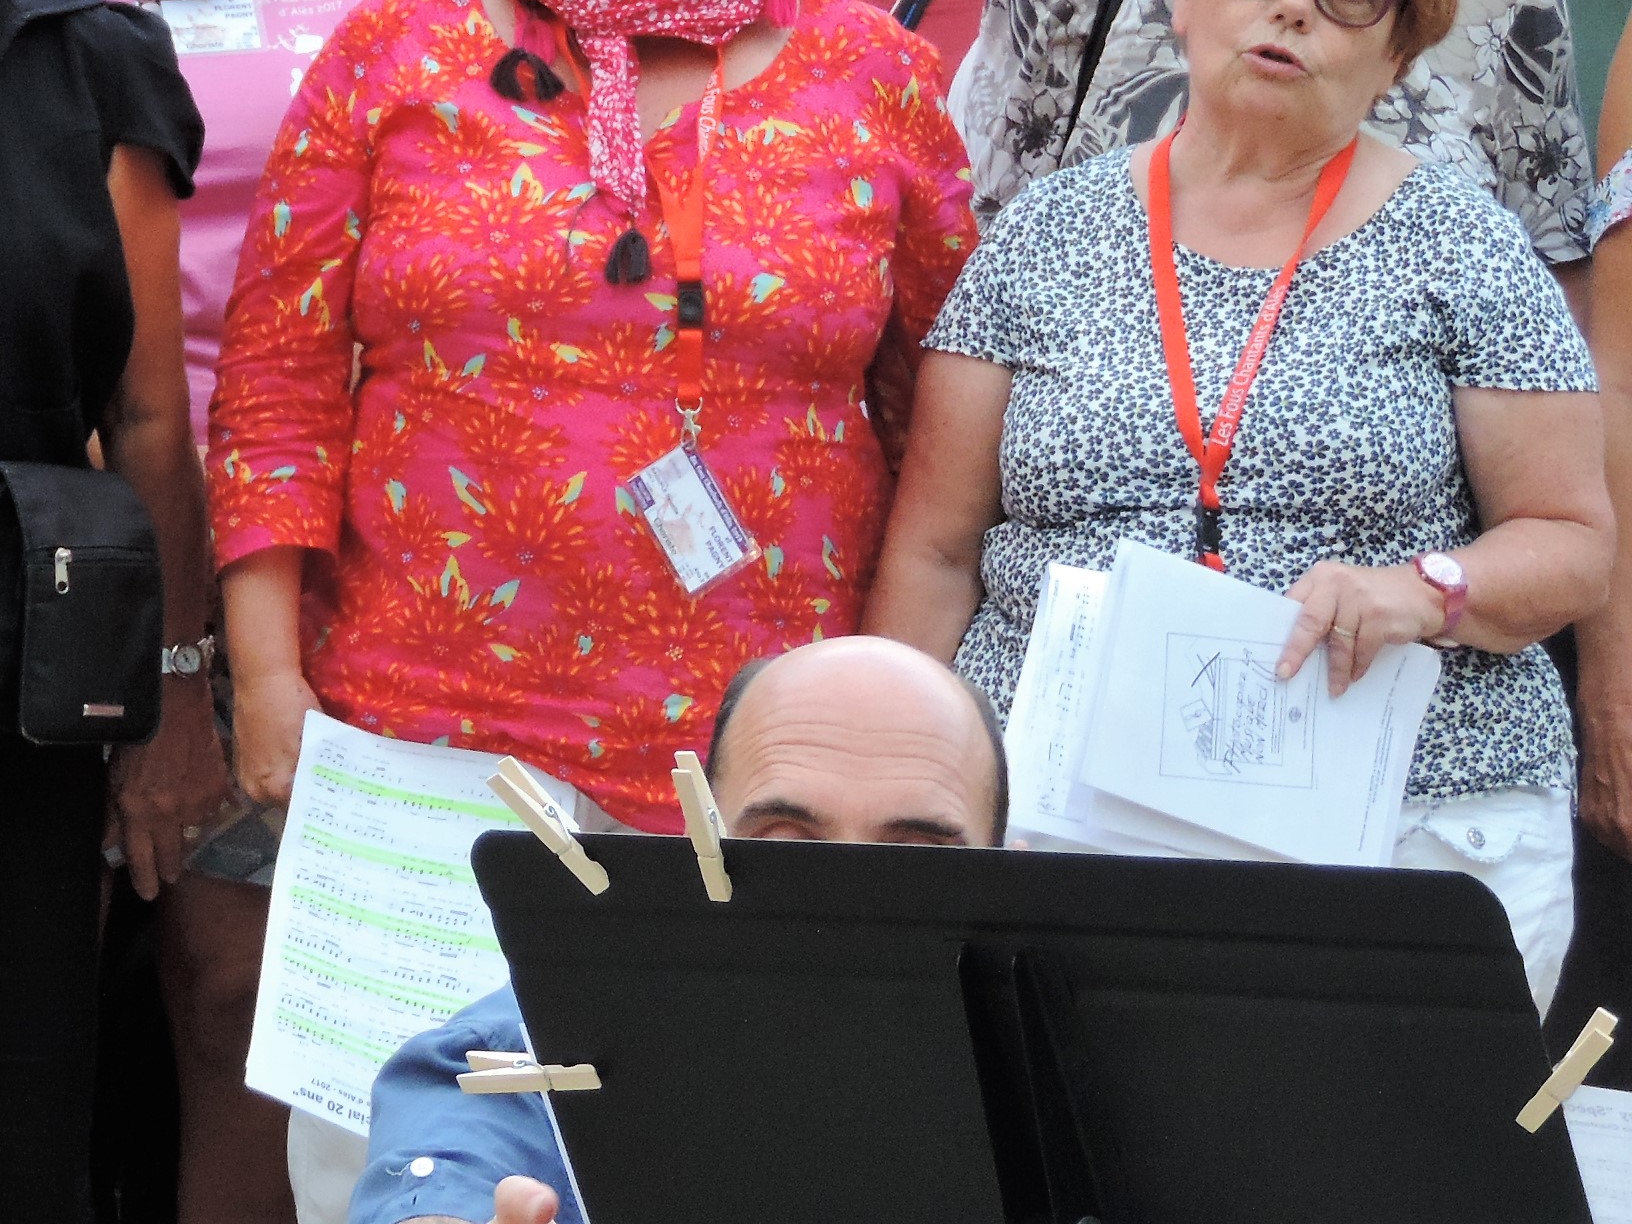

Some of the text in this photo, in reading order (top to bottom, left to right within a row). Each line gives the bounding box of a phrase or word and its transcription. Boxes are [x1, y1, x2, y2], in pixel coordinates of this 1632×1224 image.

[700, 88, 720, 115] Fous
[1232, 324, 1267, 386] Chantants
[1219, 387, 1246, 419] Fous
[1211, 420, 1234, 447] Les
[705, 540, 726, 569] PAGNY
[709, 526, 733, 564] FLORENT
[311, 1077, 331, 1091] 2017
[327, 1100, 344, 1115] 20
